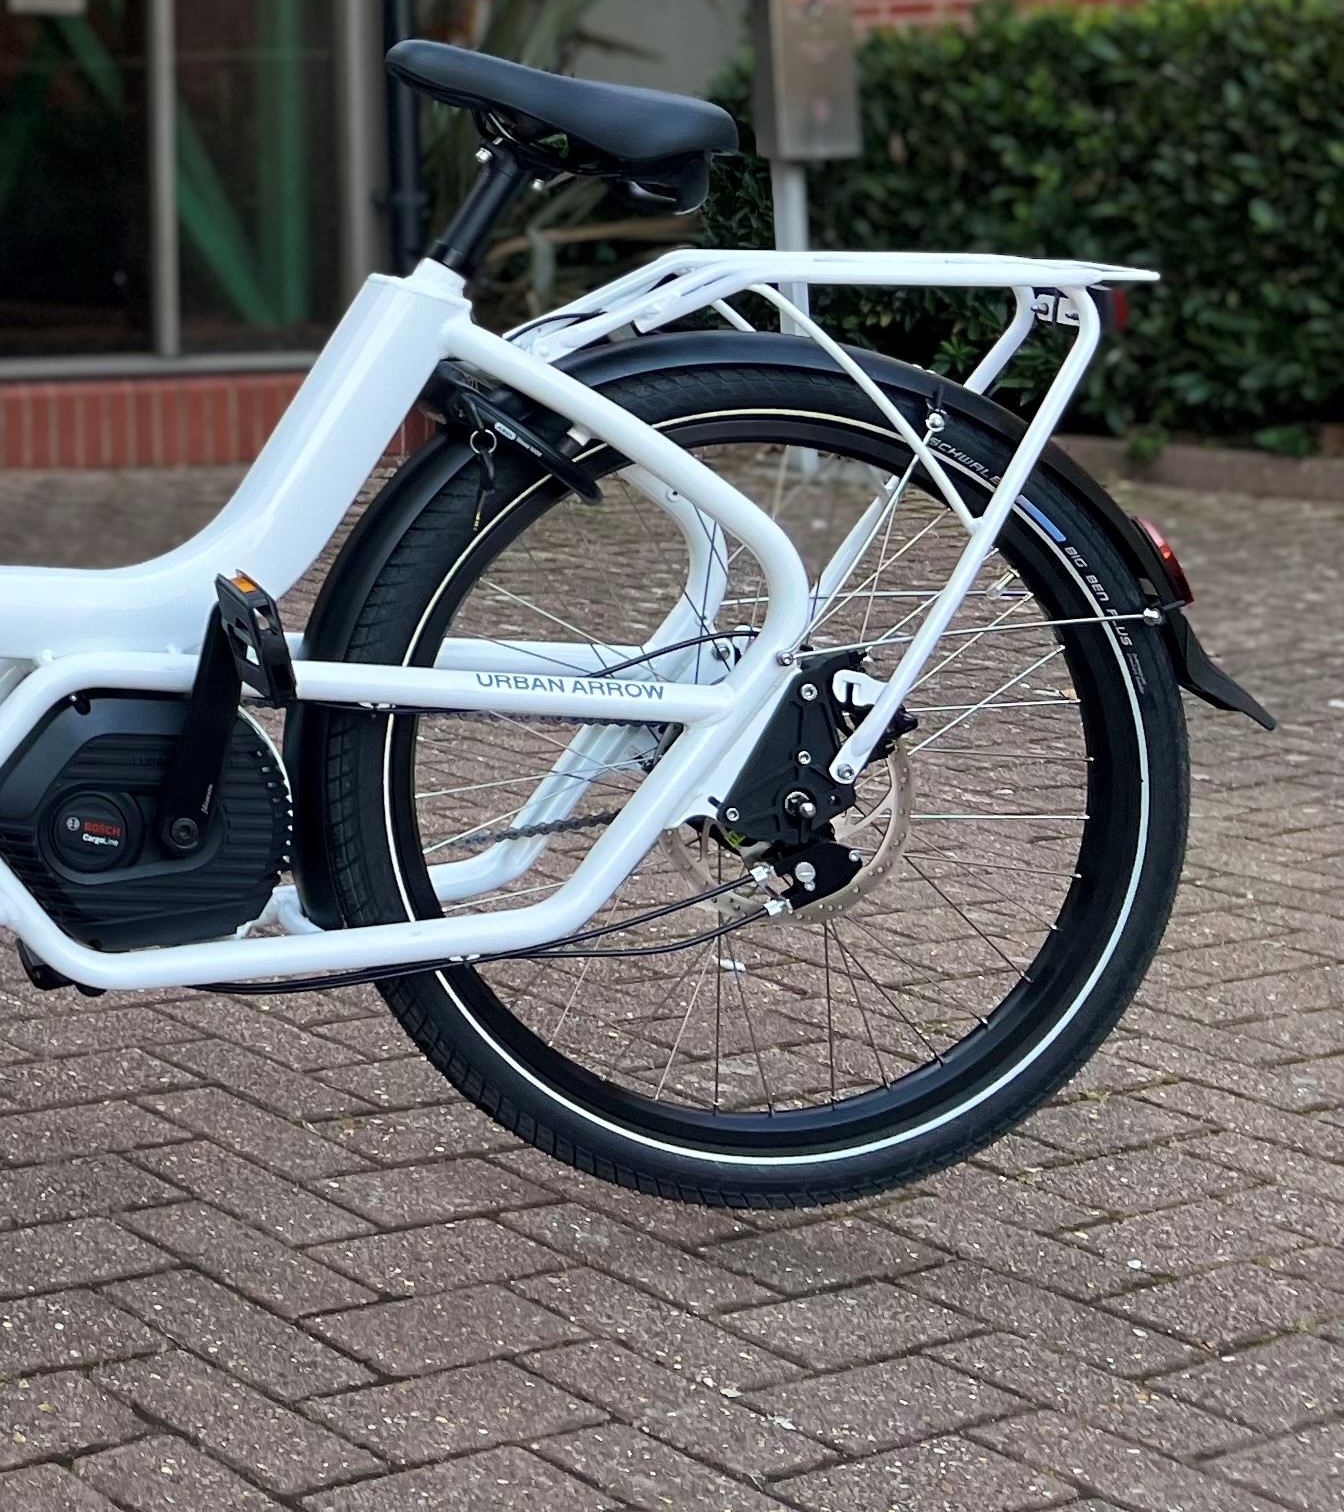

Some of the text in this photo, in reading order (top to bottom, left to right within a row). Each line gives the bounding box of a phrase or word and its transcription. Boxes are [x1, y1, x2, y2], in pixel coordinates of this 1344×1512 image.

[476, 674, 663, 700] URBAN ARROW
[84, 822, 121, 837] BOSCH
